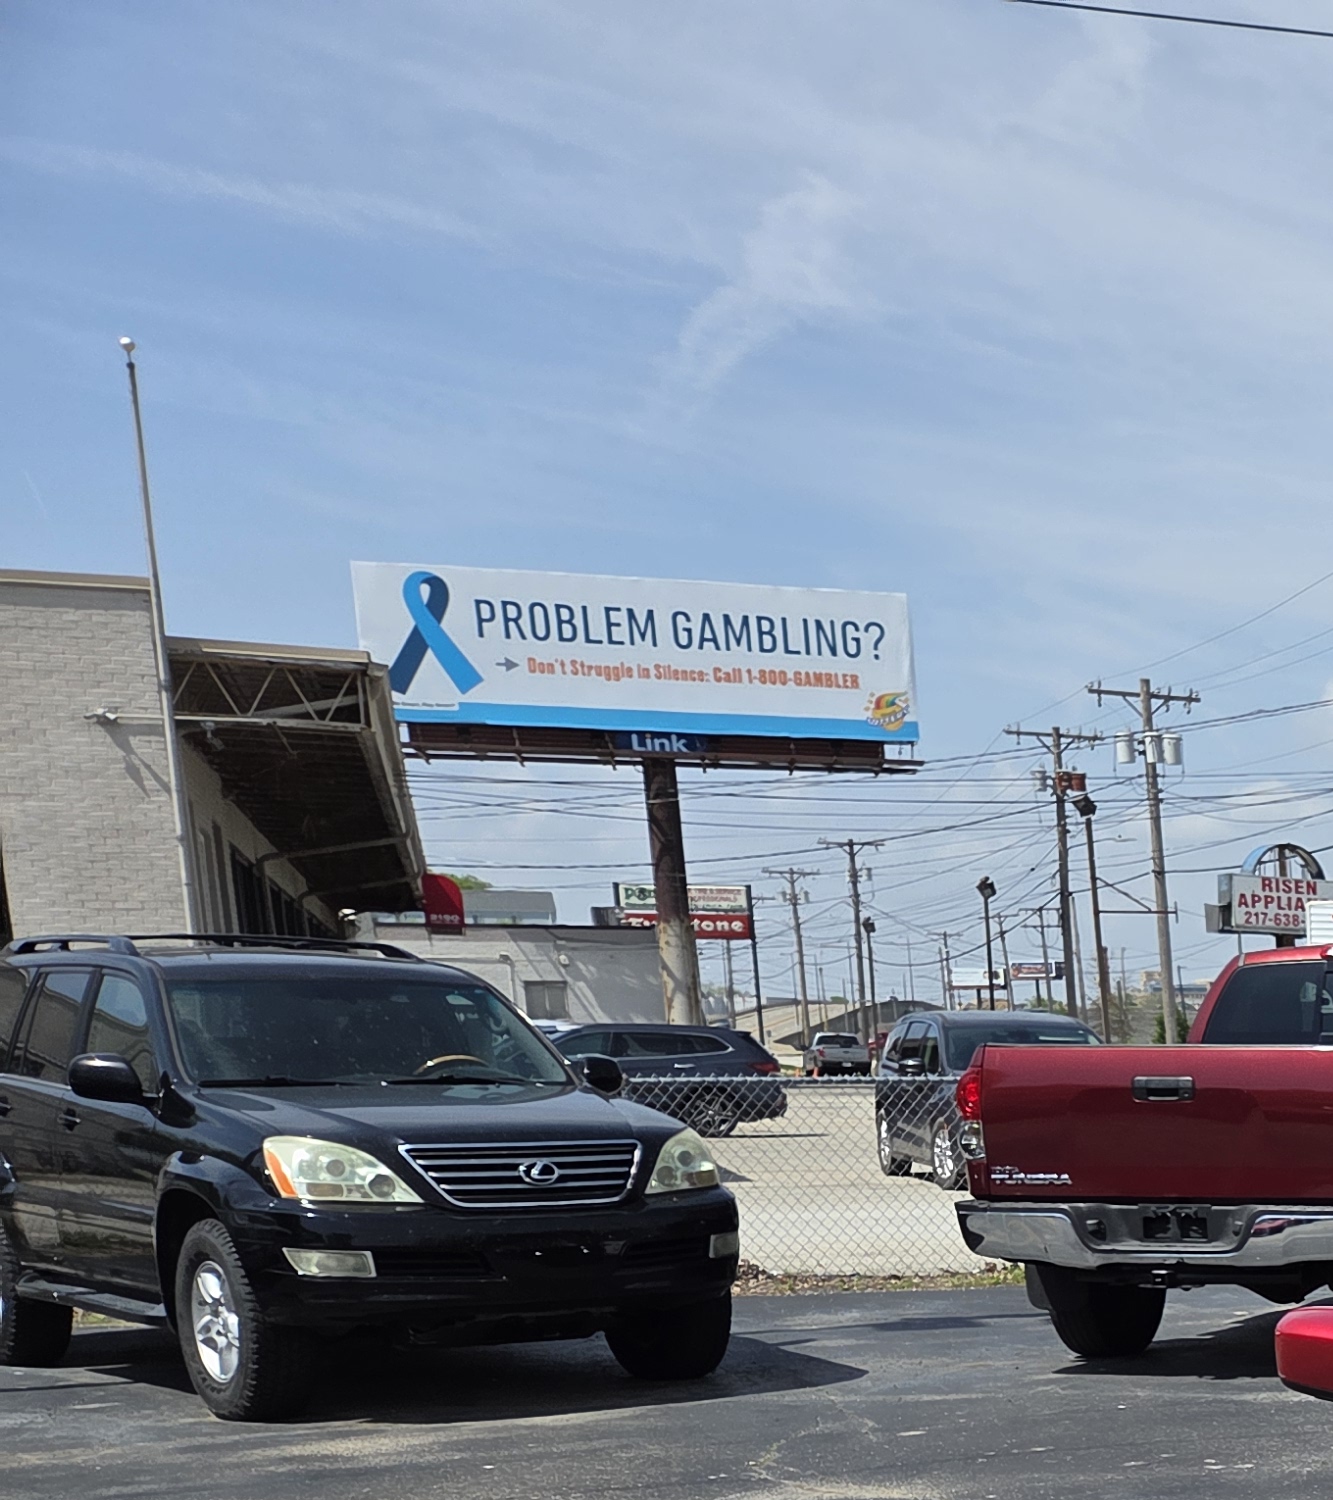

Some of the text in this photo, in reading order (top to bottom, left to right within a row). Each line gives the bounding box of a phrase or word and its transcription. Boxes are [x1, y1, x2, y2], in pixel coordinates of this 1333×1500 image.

[474, 598, 885, 660] PROBLEM GAMBLING?
[526, 656, 567, 675] Don't
[569, 659, 634, 682] Struggle
[653, 663, 710, 682] Silence:
[712, 666, 743, 684] Call
[745, 668, 861, 690] 1-800-GAMBLER
[630, 733, 691, 753] Link
[1261, 877, 1318, 896] RISEN
[1237, 893, 1328, 912] APPLIA
[1243, 911, 1306, 927] 217-638-
